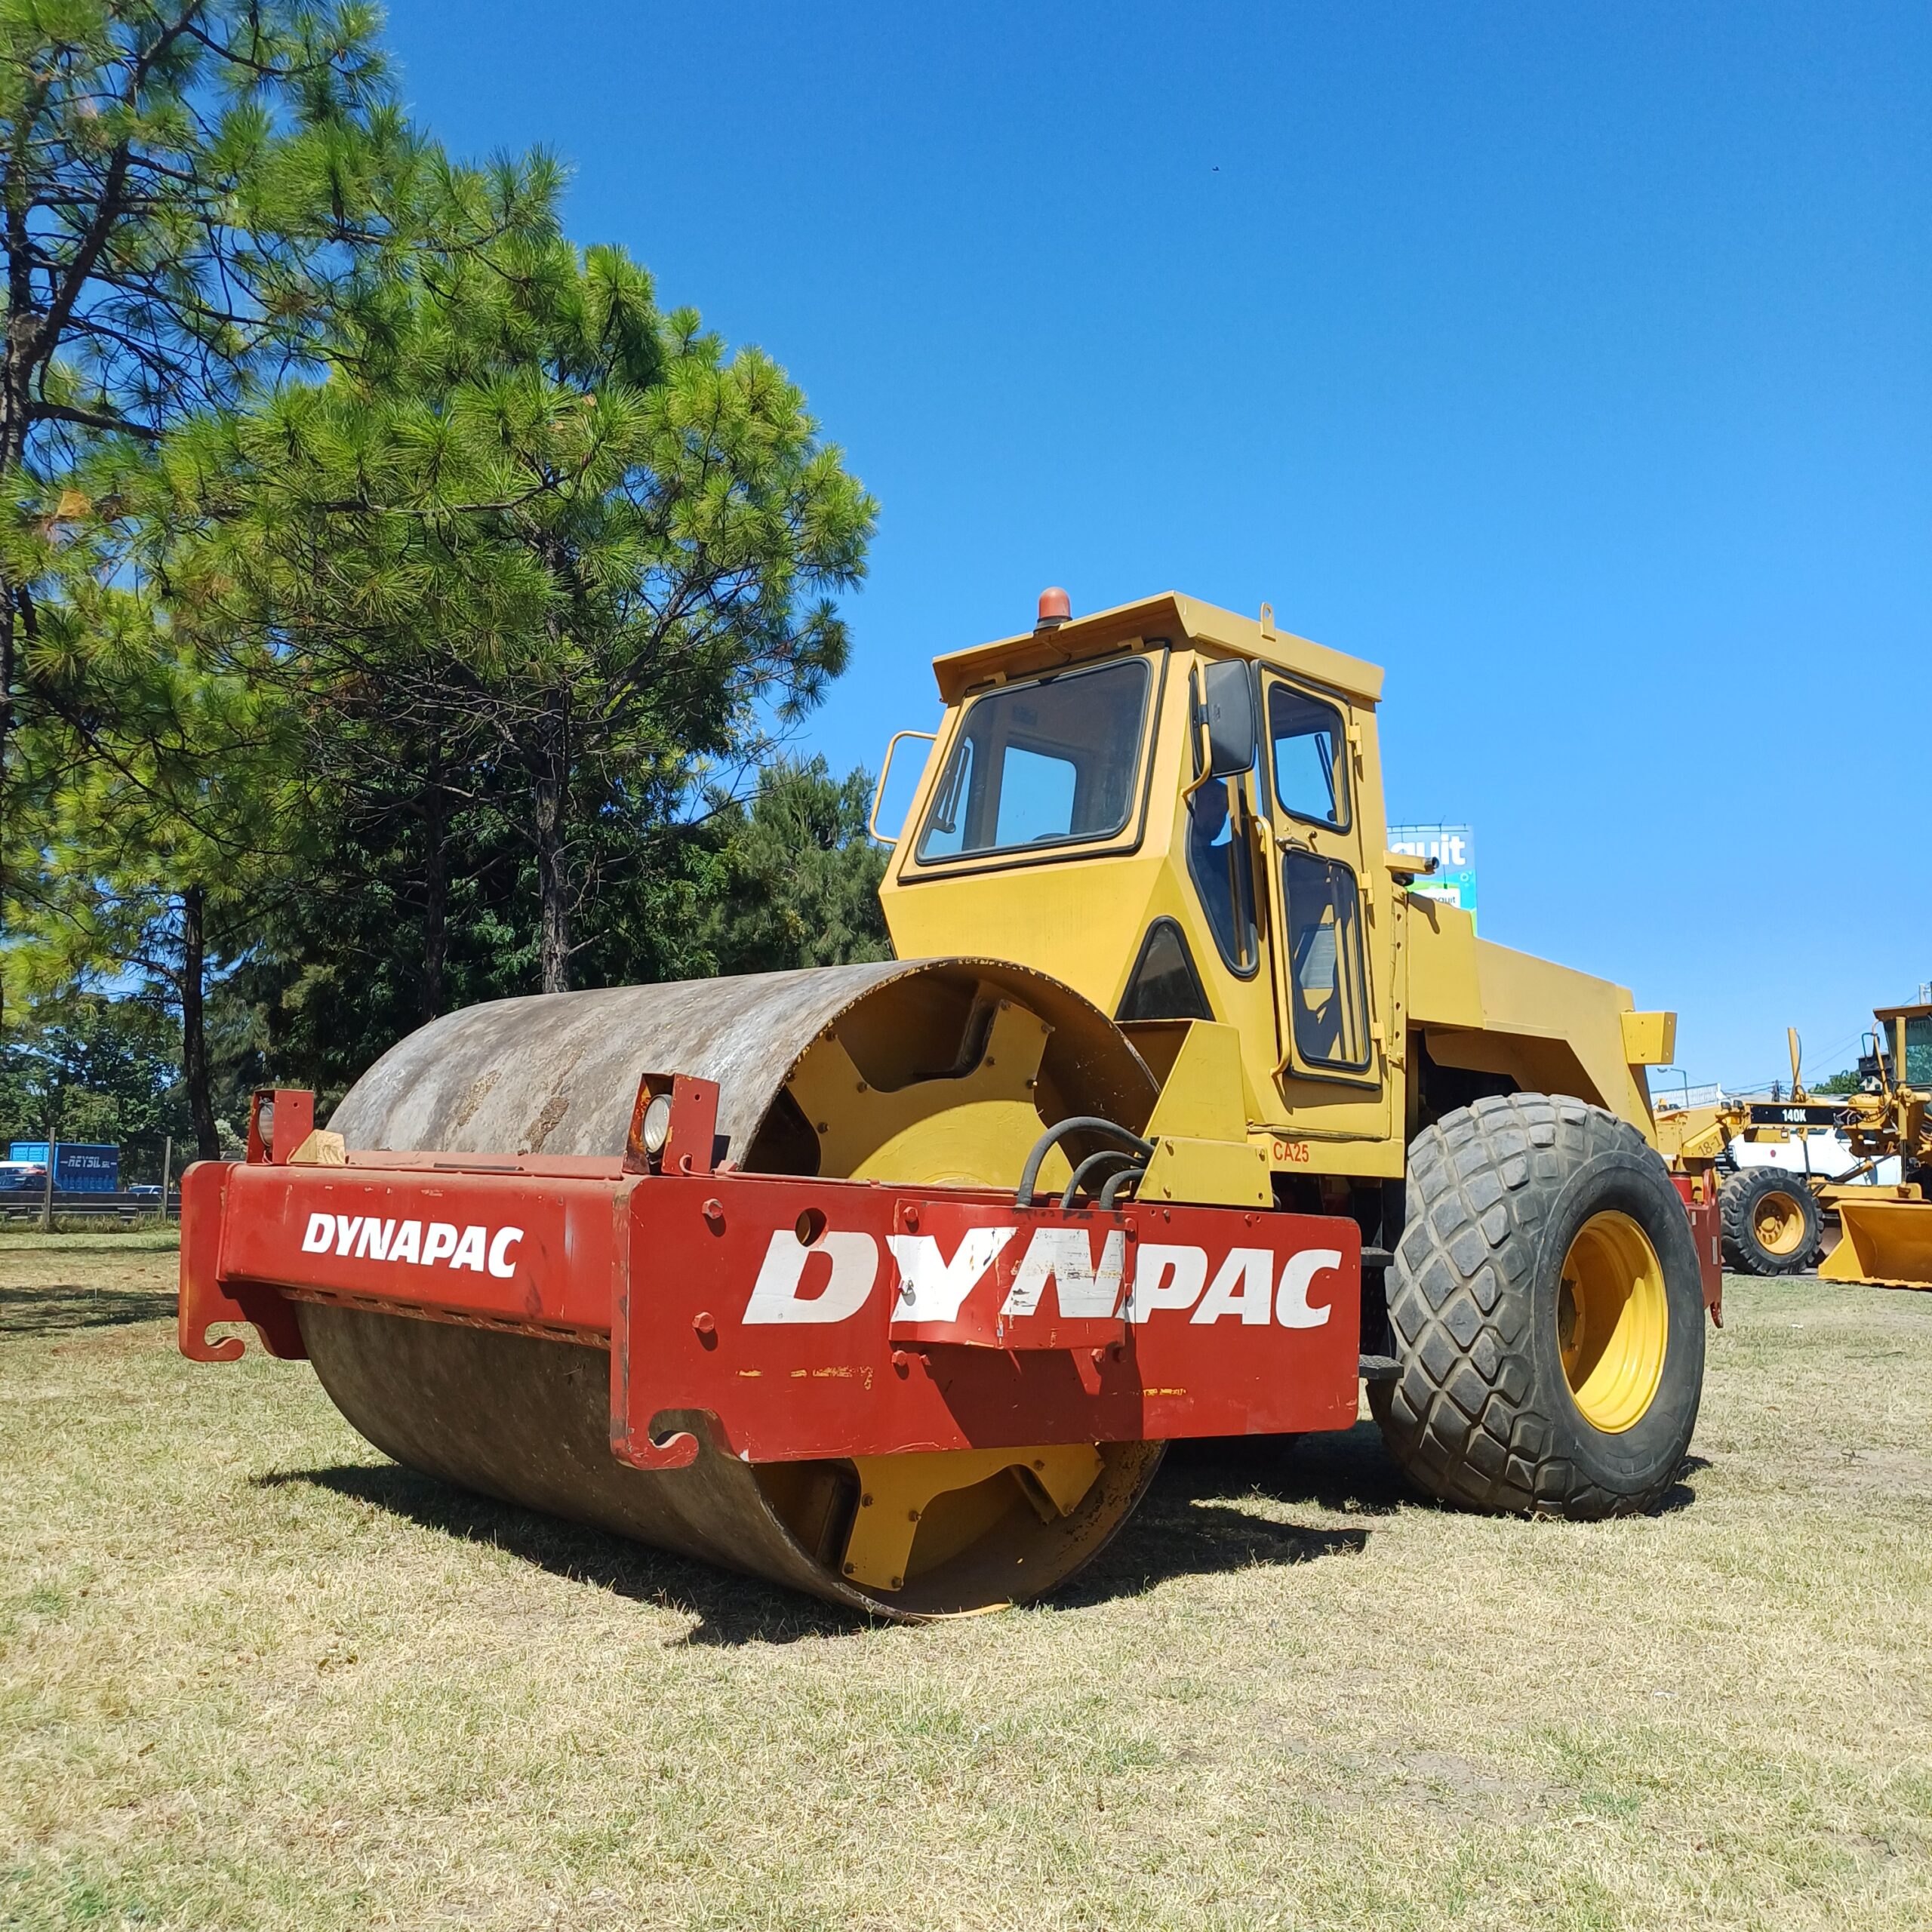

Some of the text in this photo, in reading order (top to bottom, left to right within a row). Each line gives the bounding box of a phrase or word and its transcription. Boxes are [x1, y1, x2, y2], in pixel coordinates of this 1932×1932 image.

[1782, 1109, 1807, 1122] 140K
[1273, 1141, 1309, 1162] CA25
[1698, 1135, 1723, 1155] 18-1
[301, 1212, 525, 1278] DYNAPAC
[741, 1226, 1342, 1330] DYNPAC
